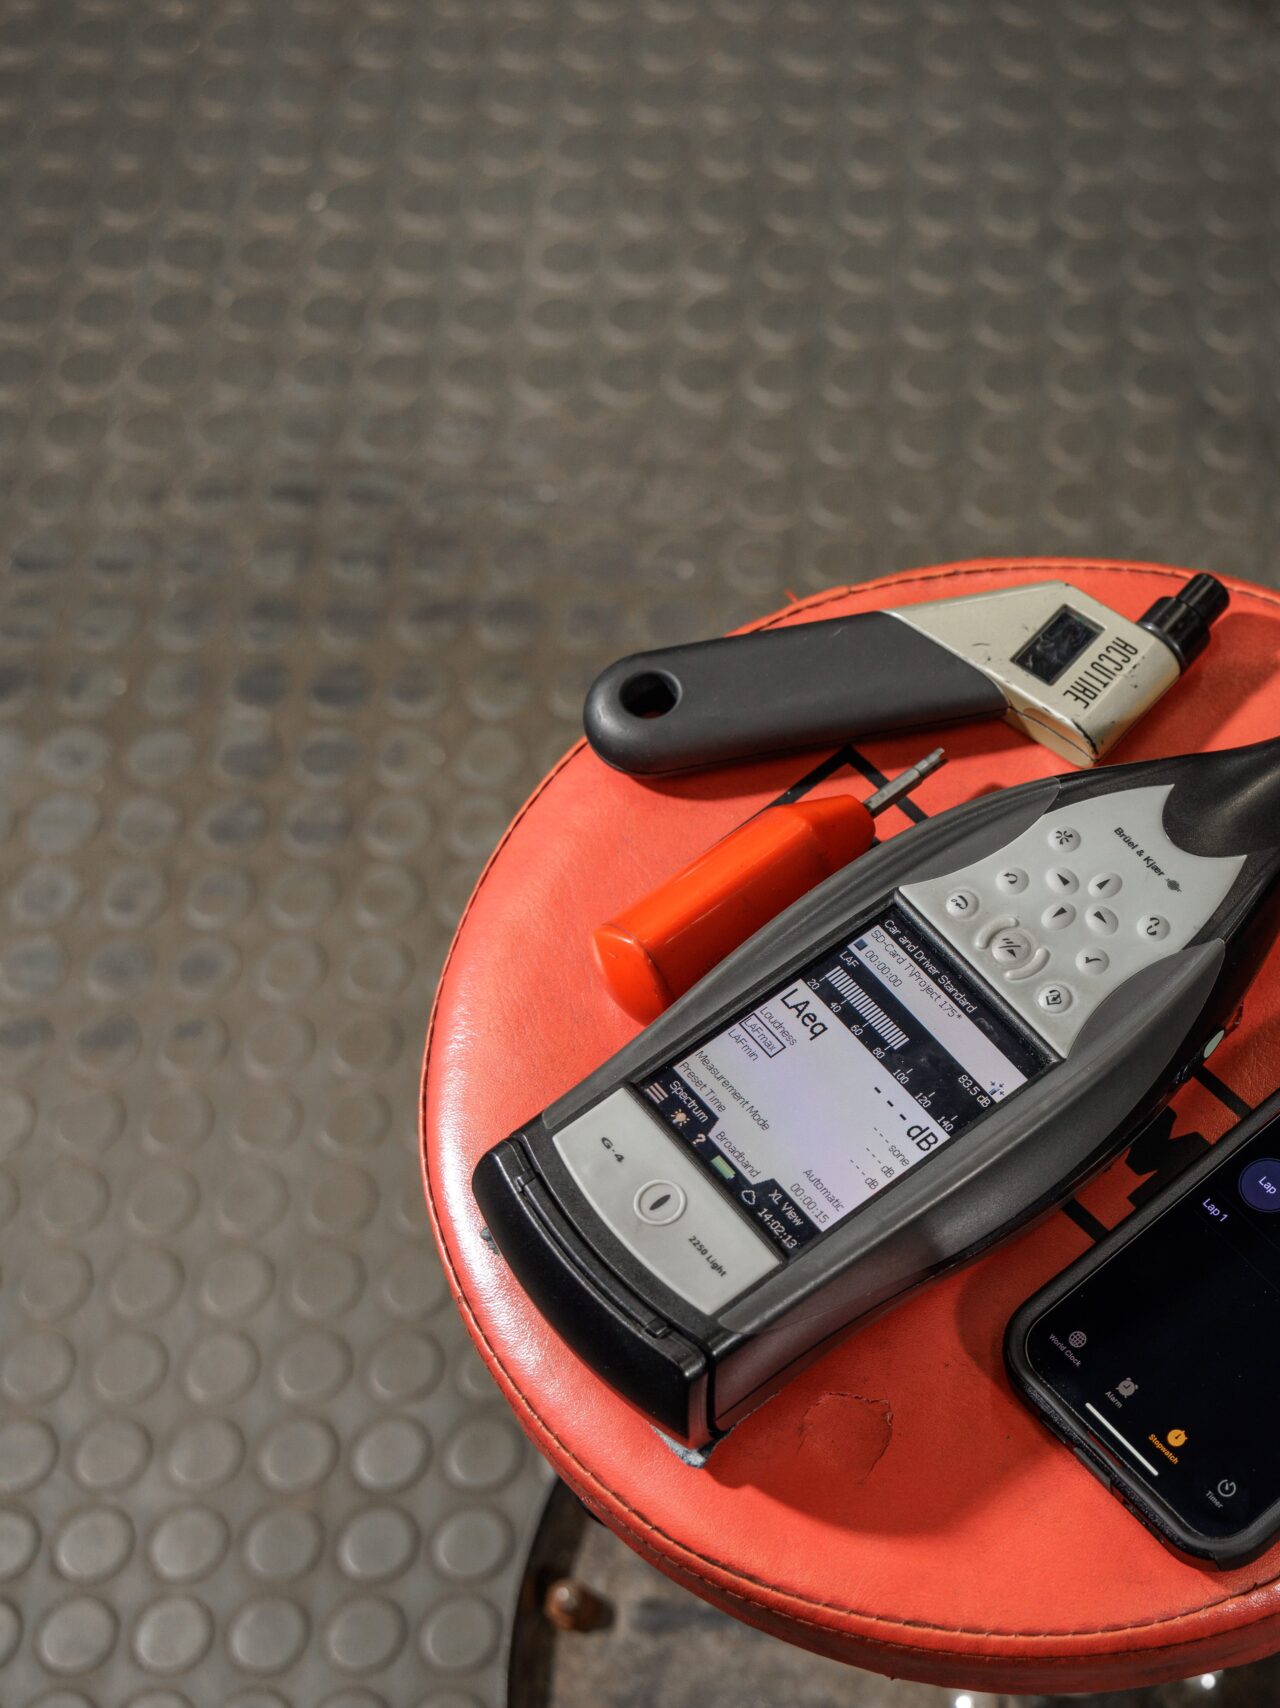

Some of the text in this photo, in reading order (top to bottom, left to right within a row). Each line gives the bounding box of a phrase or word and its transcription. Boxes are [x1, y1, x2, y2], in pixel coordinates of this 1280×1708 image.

[1063, 637, 1138, 709] ACCUTIRE
[1114, 827, 1165, 876] Brüel & Kjær
[839, 951, 860, 968] LAF
[871, 929, 905, 965] SD-Card
[884, 919, 978, 1014] Car and Driver Standard
[865, 950, 903, 988] 00:00:00
[780, 988, 939, 1151] LAeq dB
[807, 979, 954, 1132] 20 40 60 80 100 120 140
[669, 1080, 709, 1123] Spectrum
[743, 1018, 895, 1178] LAFmax dB
[759, 1006, 910, 1167] Loudness sone
[976, 1094, 991, 1108] dB
[728, 1028, 879, 1190] LAFmin dB
[679, 1062, 829, 1224] Preset Time 00:00:15
[695, 1050, 846, 1212] Measurement Mode Automatic
[715, 1131, 762, 1178] Broadband
[768, 1189, 804, 1226] XL View
[1258, 1176, 1278, 1196] Lap
[757, 1208, 798, 1249] 14:02:13
[1202, 1198, 1229, 1222] Lap 1
[688, 1234, 727, 1278] 2250 Light
[1049, 1333, 1082, 1368] World Clock
[1104, 1390, 1123, 1409] Alarm
[1148, 1433, 1180, 1465] Stopwatch
[1205, 1490, 1224, 1509] Timer
